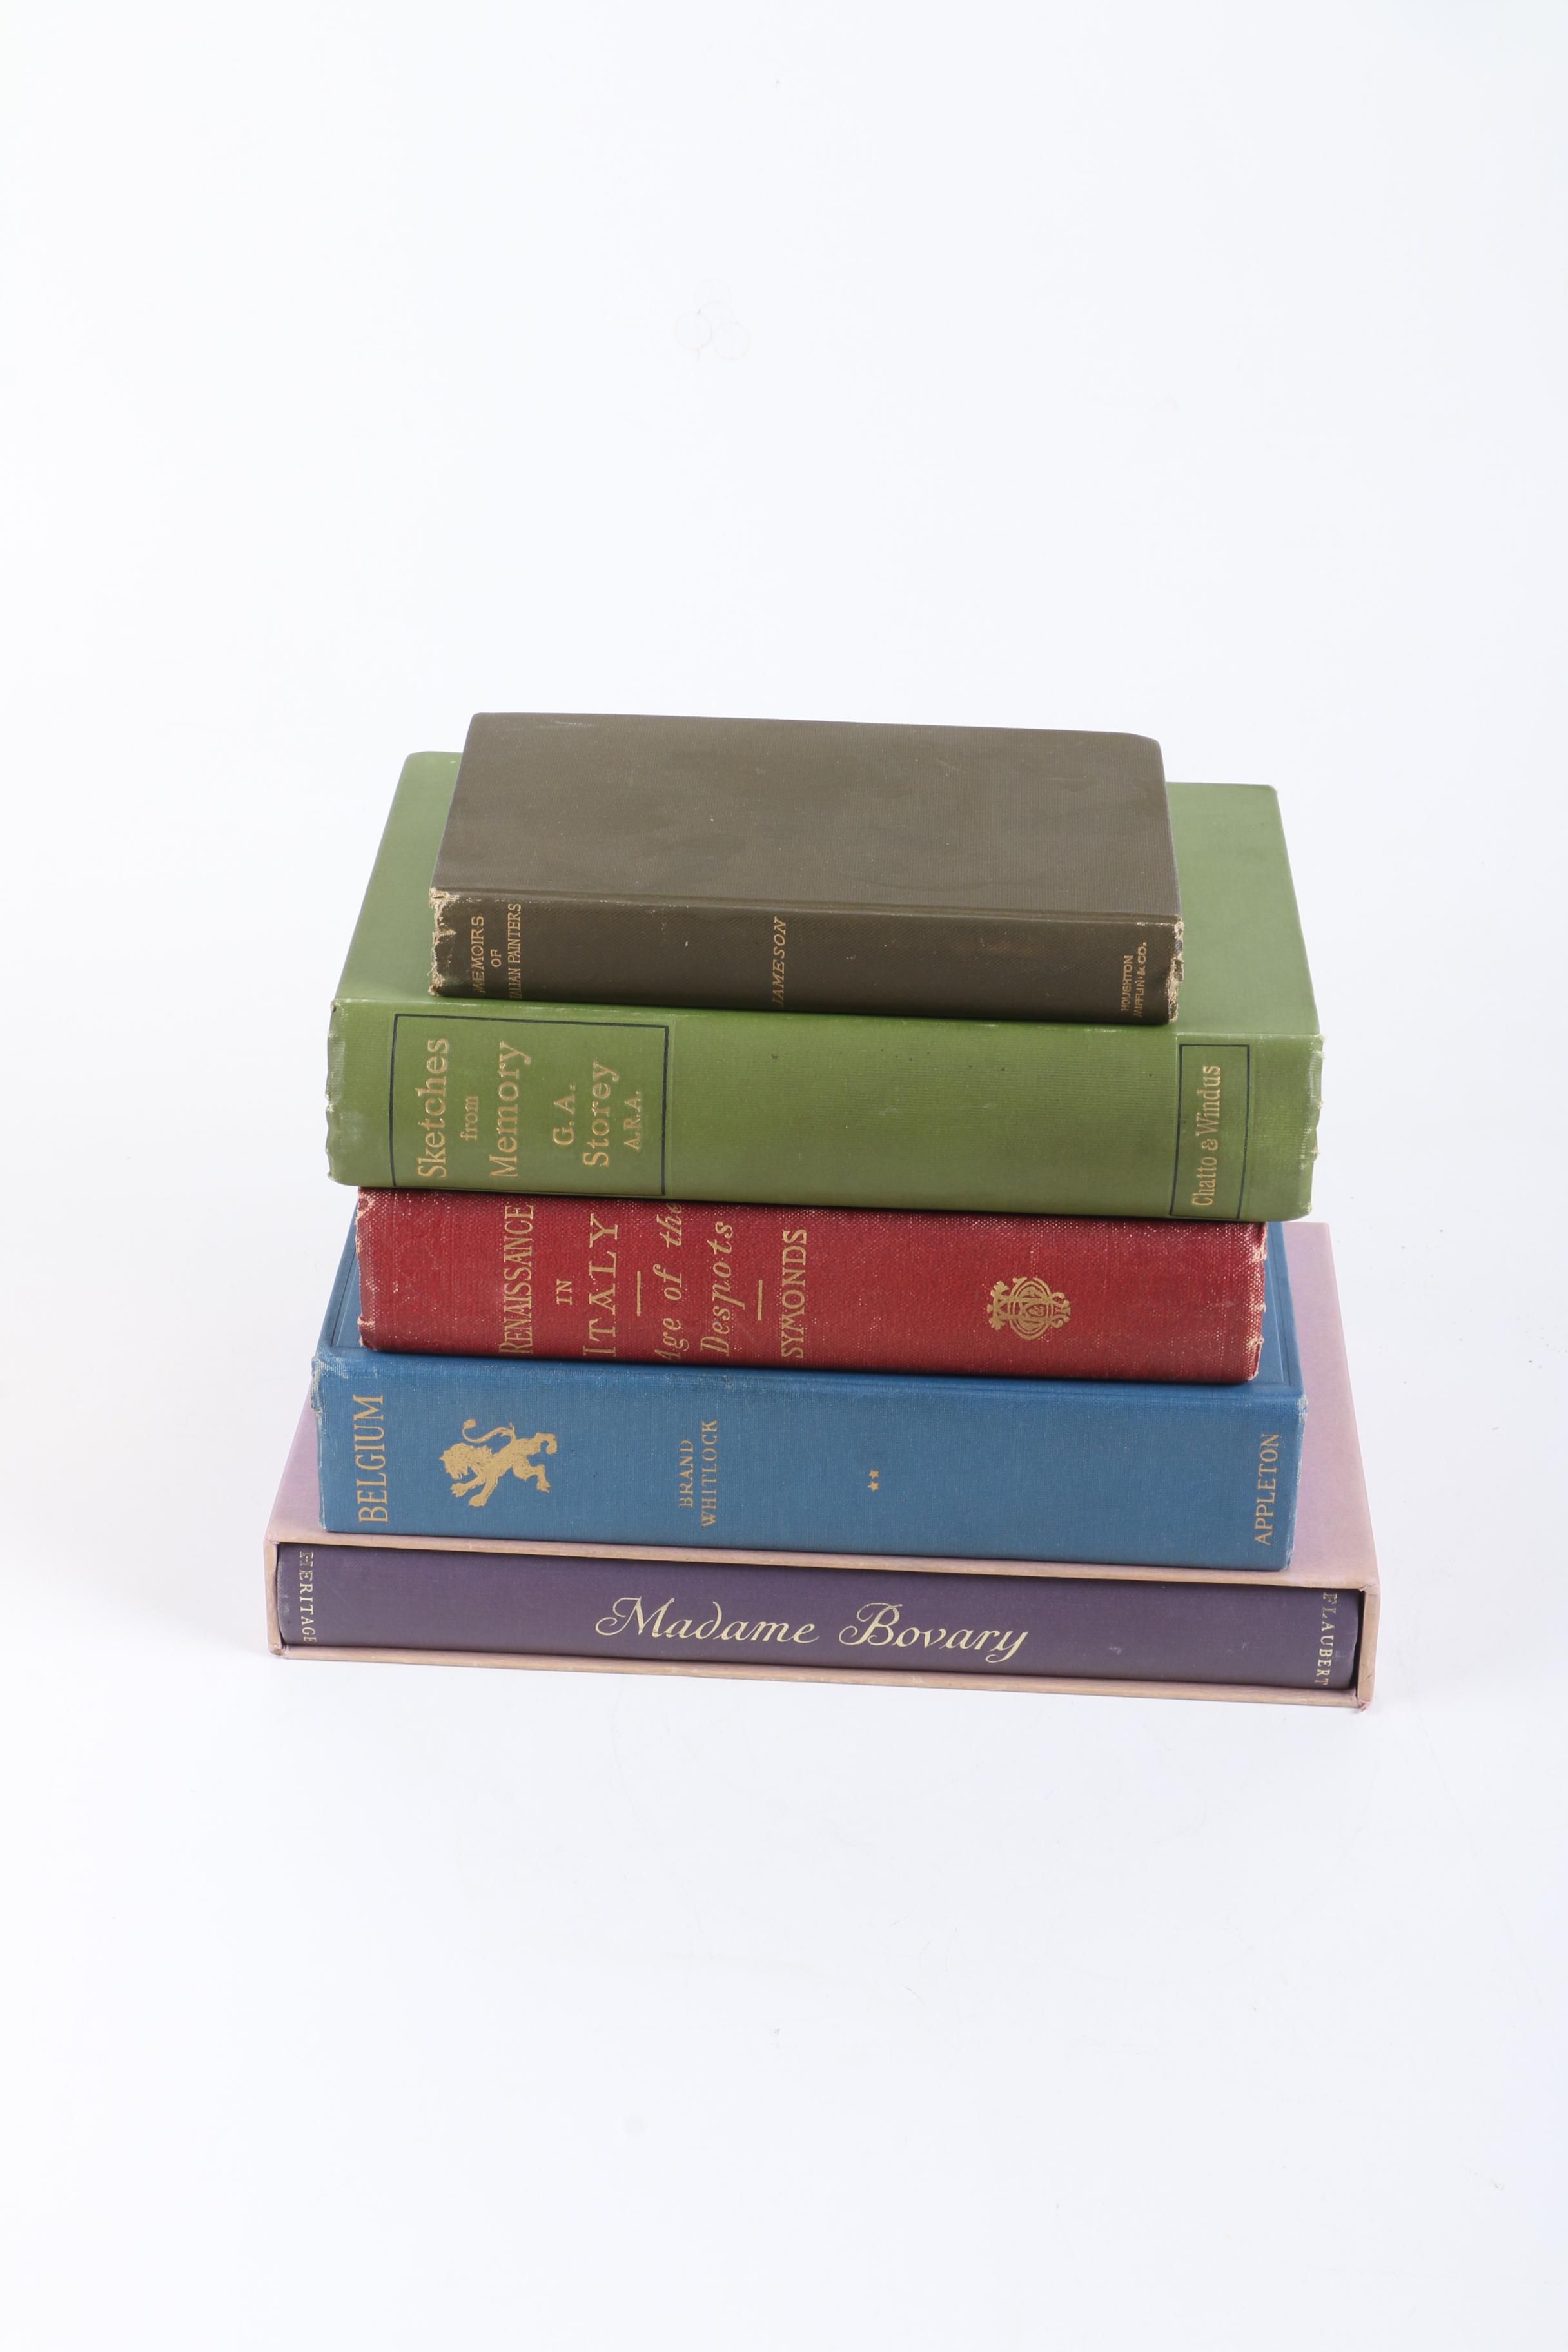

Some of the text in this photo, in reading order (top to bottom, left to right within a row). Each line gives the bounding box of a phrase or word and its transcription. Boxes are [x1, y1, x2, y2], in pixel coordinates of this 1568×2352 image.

[490, 949, 502, 968] OF
[507, 903, 522, 963] PAINTERS
[1137, 941, 1148, 965] CO.
[1121, 955, 1133, 1012] HOUGHTON
[415, 1037, 449, 1179] Sketches
[460, 1095, 479, 1142] from
[489, 1040, 533, 1178] Memory
[553, 1121, 576, 1146] G.
[583, 1058, 619, 1168] Storey
[623, 1090, 642, 1152] A.R.A.
[1191, 1064, 1221, 1208] Chatto & Windus
[656, 1202, 683, 1248] the
[498, 1204, 534, 1355] RENAISSANCE
[556, 1279, 573, 1305] IN
[583, 1213, 618, 1357] ITALY
[652, 1264, 682, 1301] of
[700, 1220, 745, 1357] Despots
[781, 1228, 807, 1360] SYMONDS
[352, 1393, 389, 1524] BELGIUM
[678, 1439, 694, 1508] BRAND
[701, 1418, 718, 1528] WHITLOCK
[1253, 1433, 1280, 1546] APPLETON
[299, 1551, 317, 1643] HERITAGE
[594, 1596, 1030, 1663] Madame Bovary
[1315, 1591, 1338, 1686] FLAUBERT
